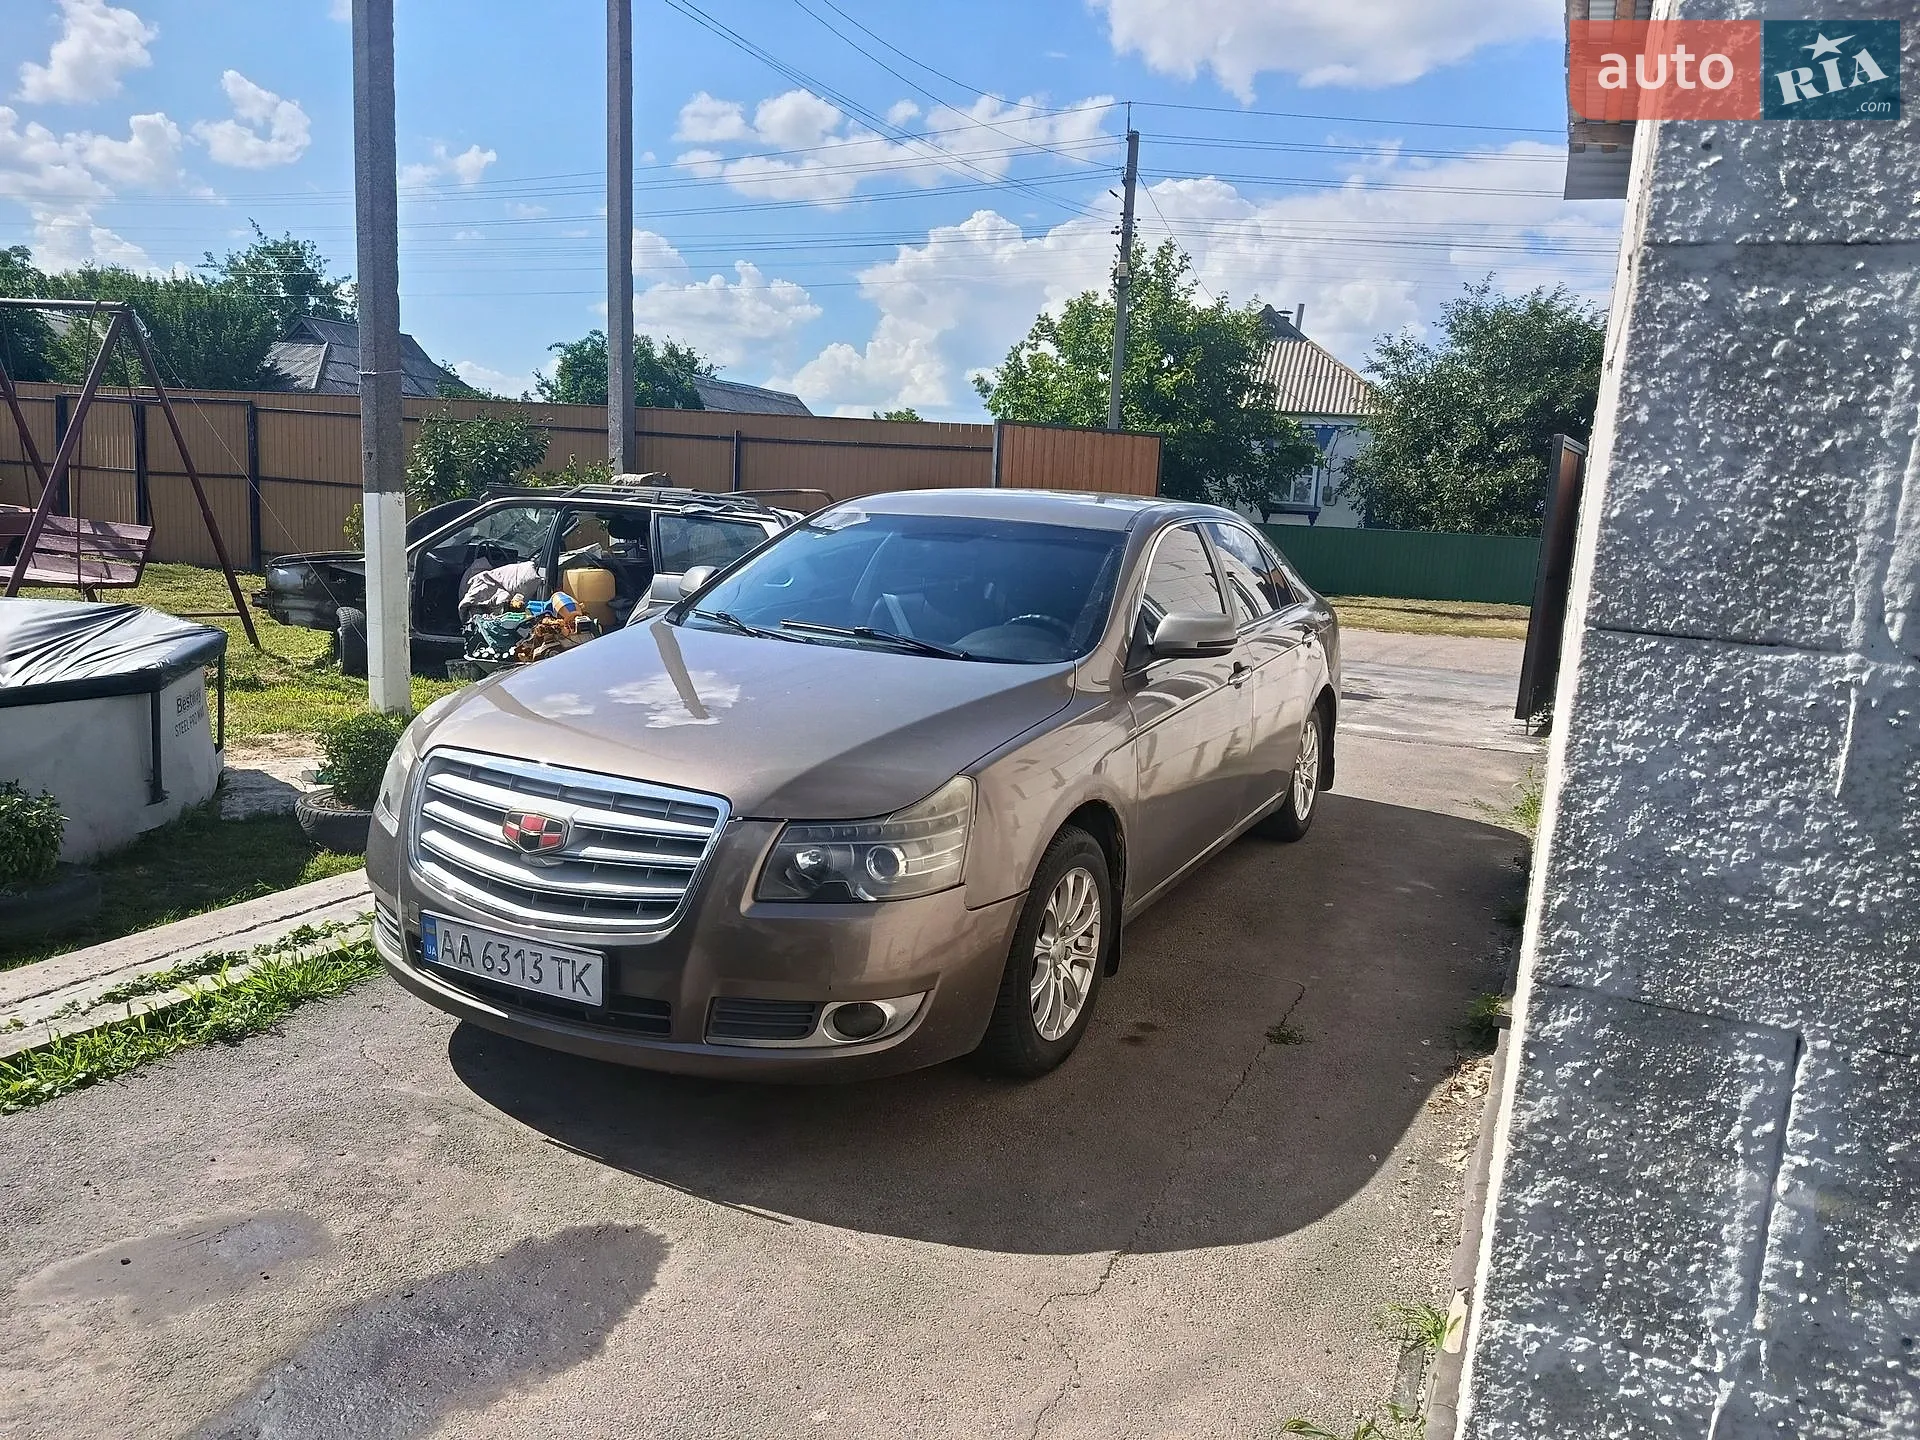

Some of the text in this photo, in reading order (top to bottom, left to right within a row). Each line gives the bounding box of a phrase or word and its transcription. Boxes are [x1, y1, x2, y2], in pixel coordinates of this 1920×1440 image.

[427, 943, 437, 957] UA
[439, 929, 592, 997] AA 6313 TK
